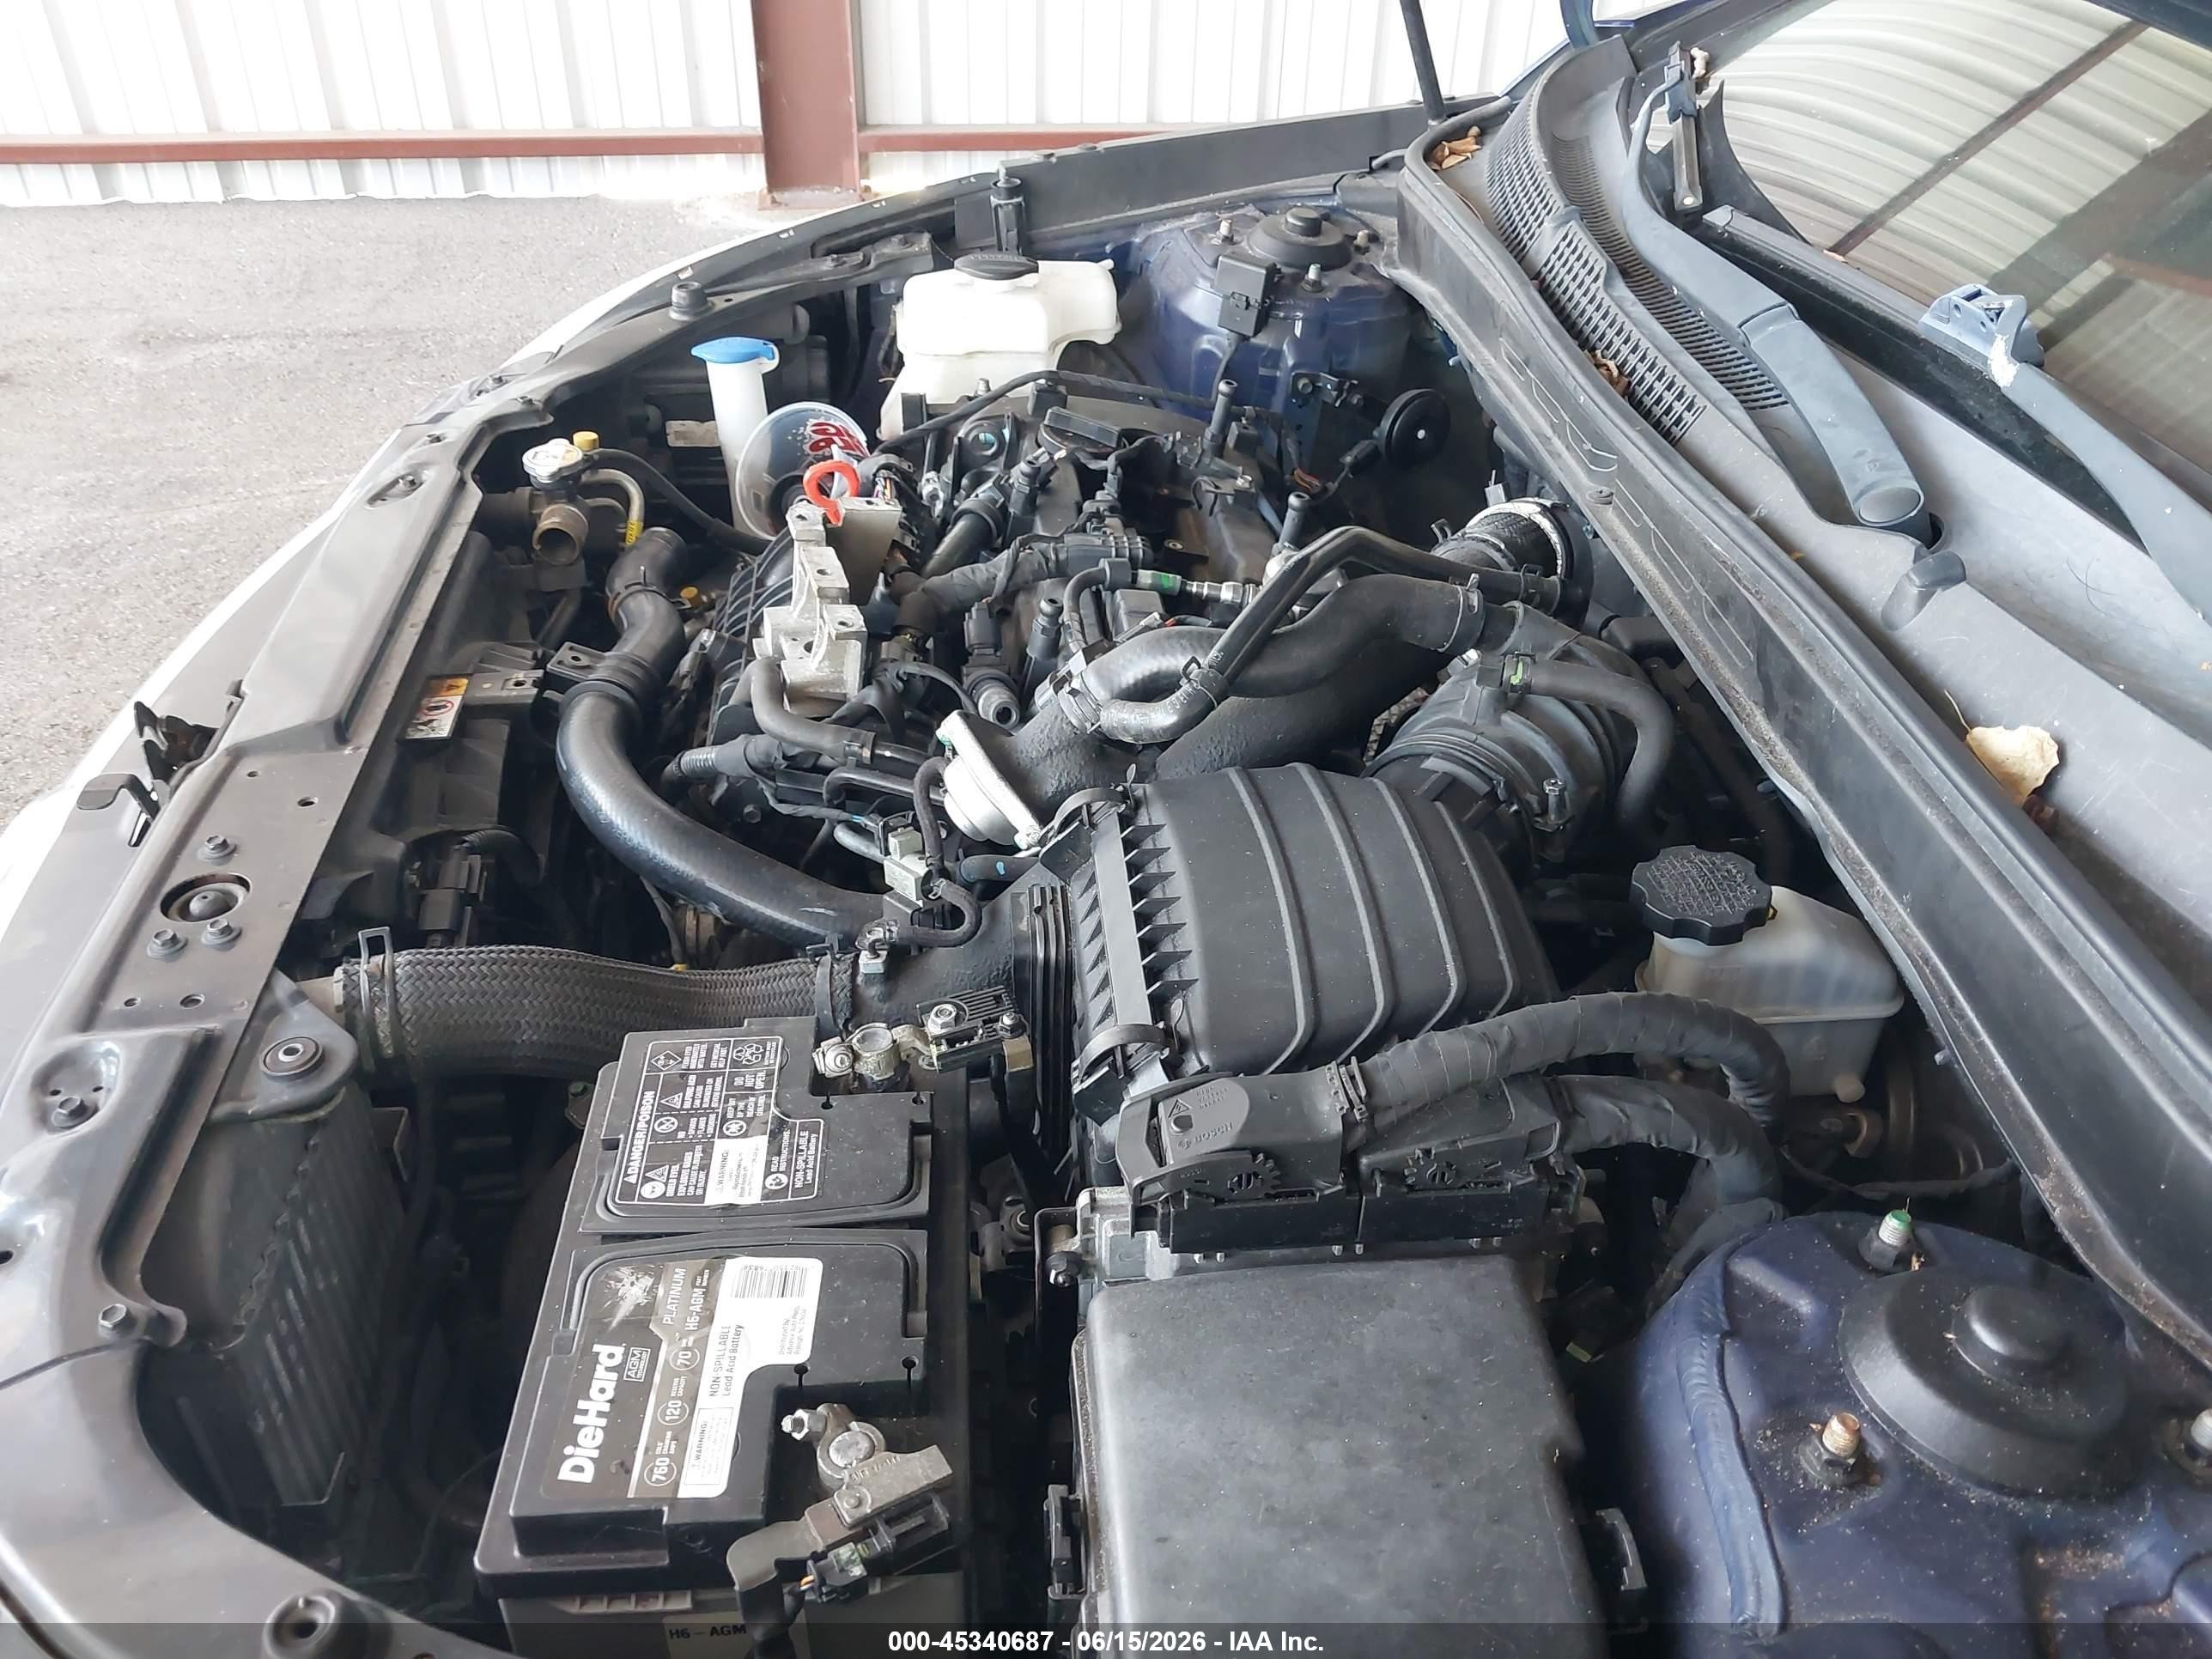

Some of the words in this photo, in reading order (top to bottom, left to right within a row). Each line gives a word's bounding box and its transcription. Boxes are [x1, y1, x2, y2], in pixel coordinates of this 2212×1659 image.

[733, 1076, 744, 1085] DO
[744, 1073, 755, 1087] NOT
[755, 1069, 767, 1090] OPEN.
[626, 1091, 655, 1174] DANGER/POISON
[770, 1156, 779, 1172] READ
[794, 1130, 809, 1188] NON-SPILLABLE
[807, 1155, 816, 1169] Acid
[805, 1170, 814, 1183] Lead
[662, 1267, 687, 1325] PLATINUM
[684, 1287, 706, 1331] H6-AGM
[730, 1324, 744, 1353] Battery
[628, 1349, 642, 1379] AGM
[677, 1351, 692, 1366] 70
[708, 1325, 731, 1396] NON-SPILLABLE
[726, 1355, 737, 1373] Acid
[722, 1376, 733, 1396] Lead
[557, 1343, 625, 1483] DieHard
[665, 1400, 683, 1422] 120
[652, 1457, 671, 1482] 760
[669, 1628, 691, 1640] H6
[709, 1624, 748, 1637] AGM
